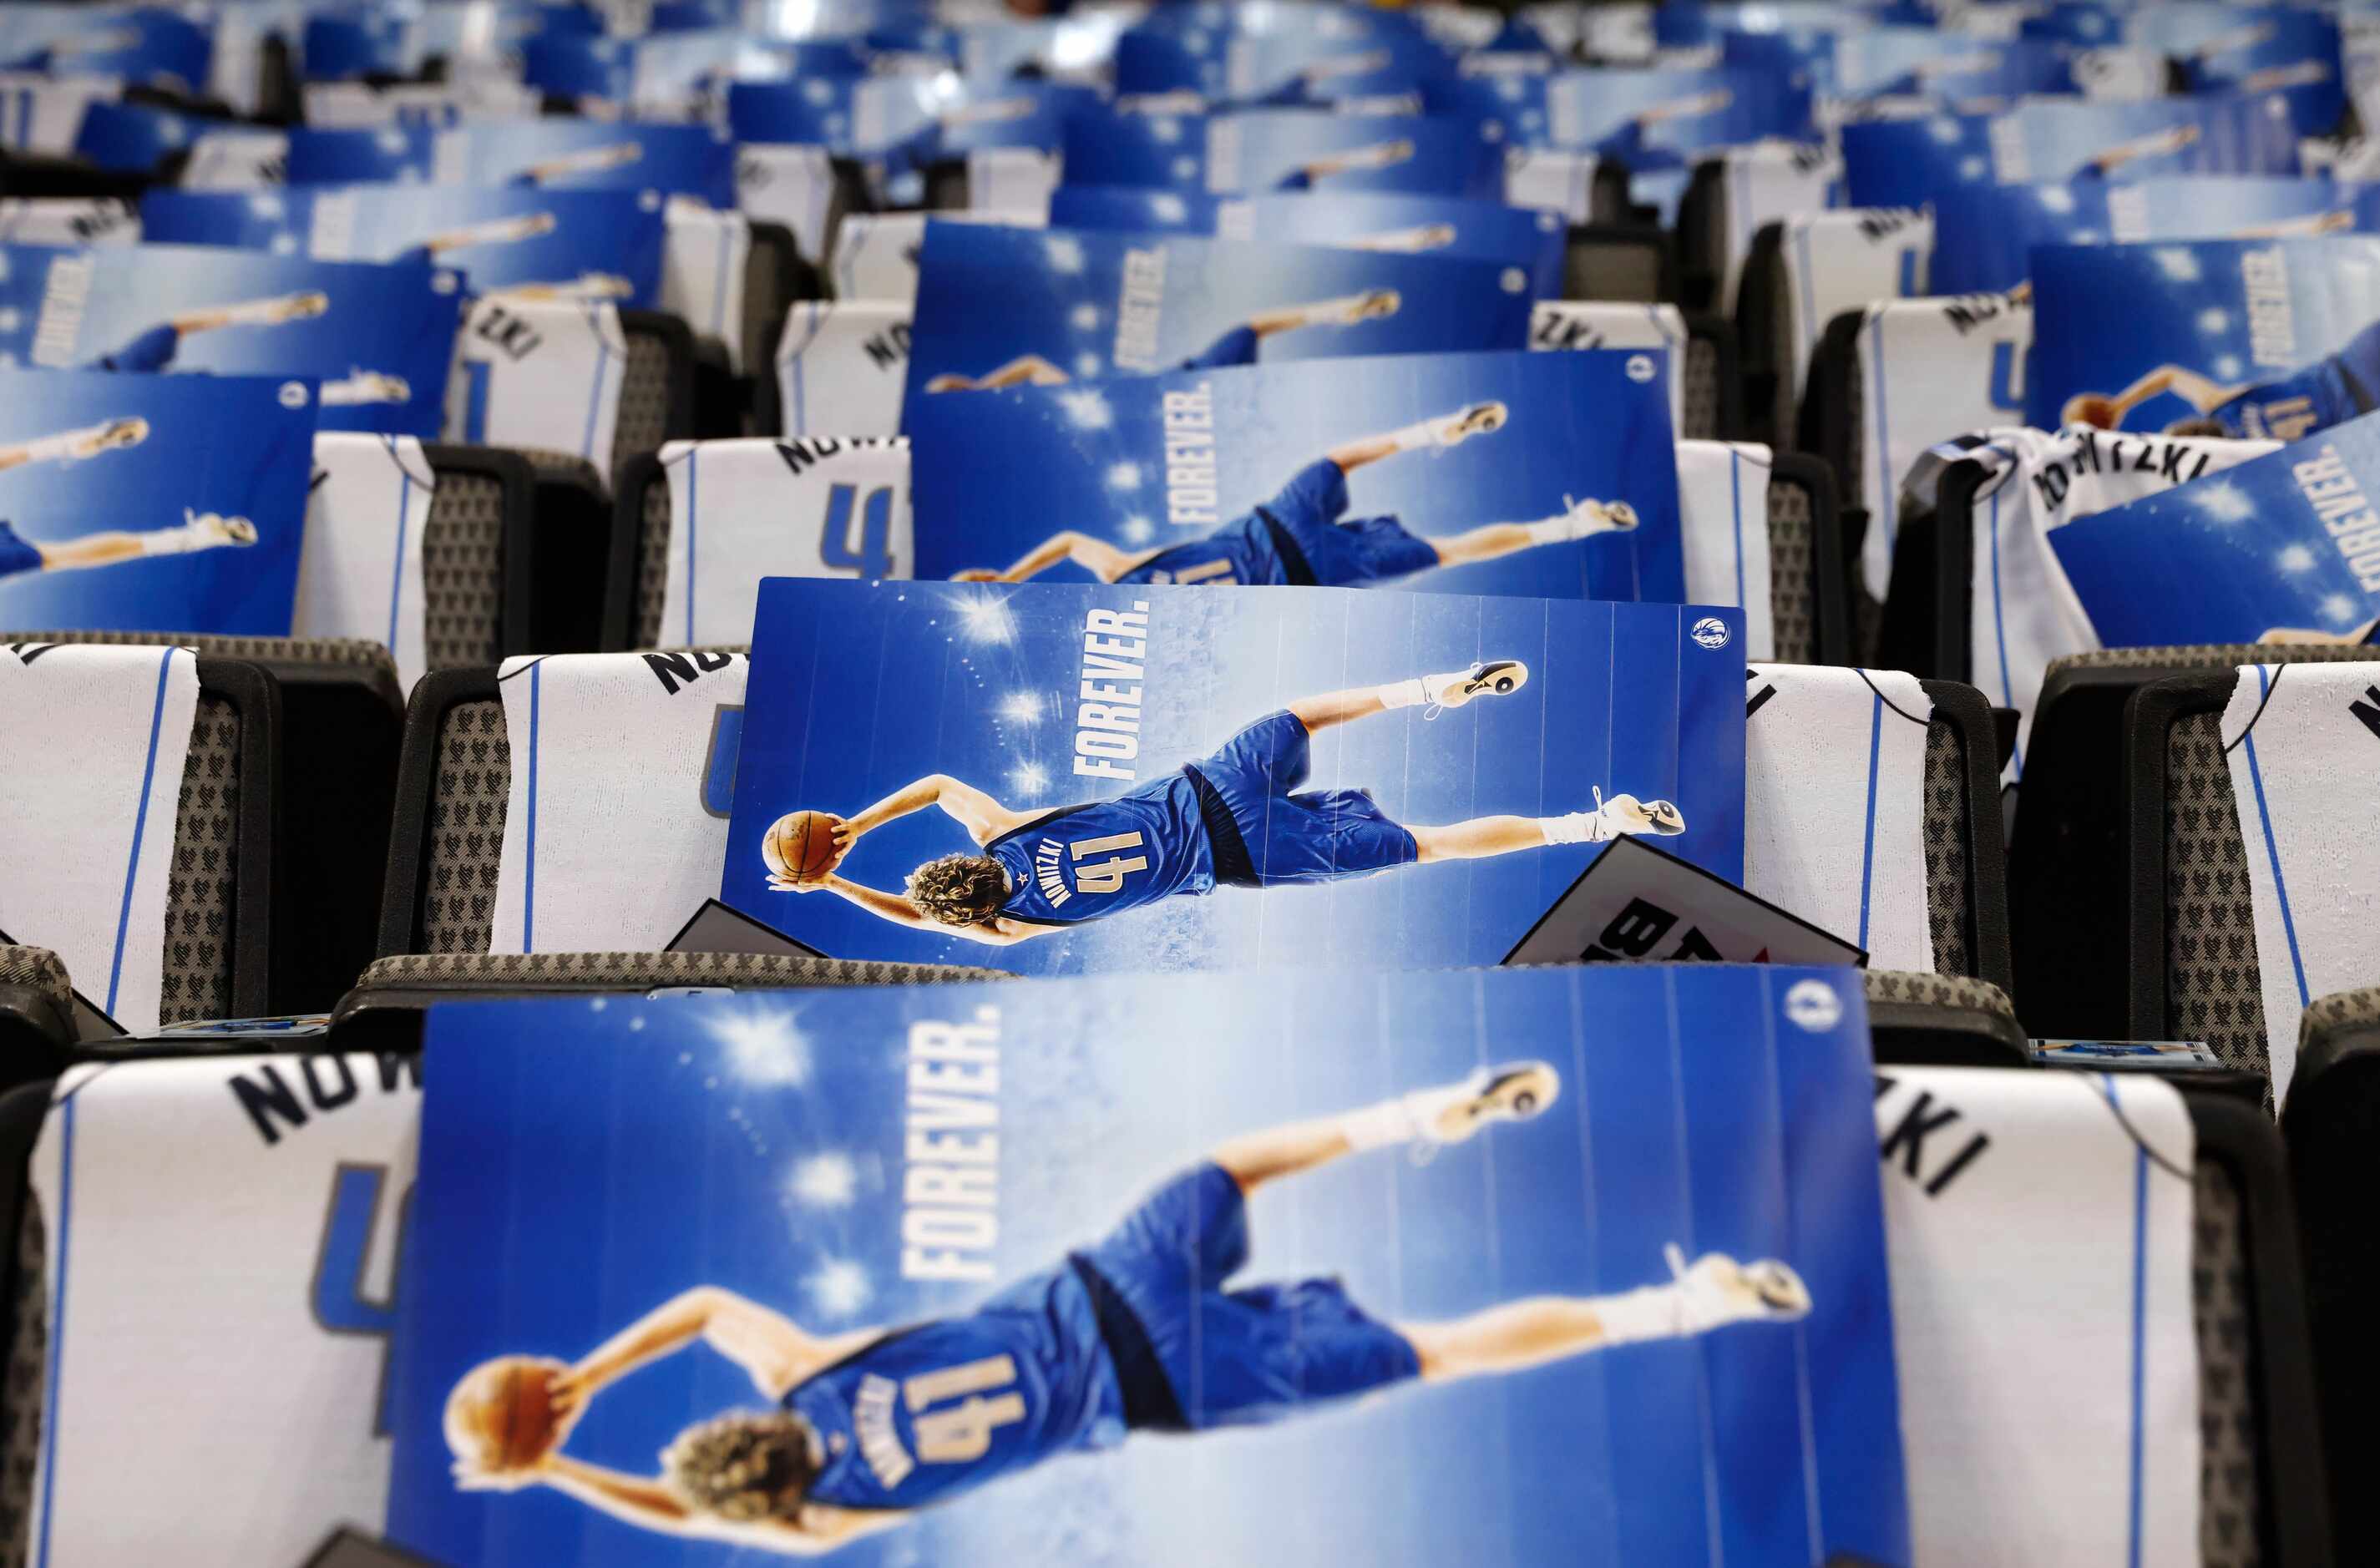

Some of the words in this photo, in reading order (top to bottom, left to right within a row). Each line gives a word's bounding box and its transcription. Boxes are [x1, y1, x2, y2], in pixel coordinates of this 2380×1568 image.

[1164, 379, 1218, 524] FOREVER.
[1175, 557, 1238, 584] 1
[1073, 599, 1151, 781] FOREVER.
[1036, 837, 1072, 909] NOWITZKI
[1069, 831, 1149, 894] 41
[899, 1004, 1003, 1280] FOREVER.
[1876, 1075, 1992, 1199] KI
[904, 1353, 1027, 1465] 41
